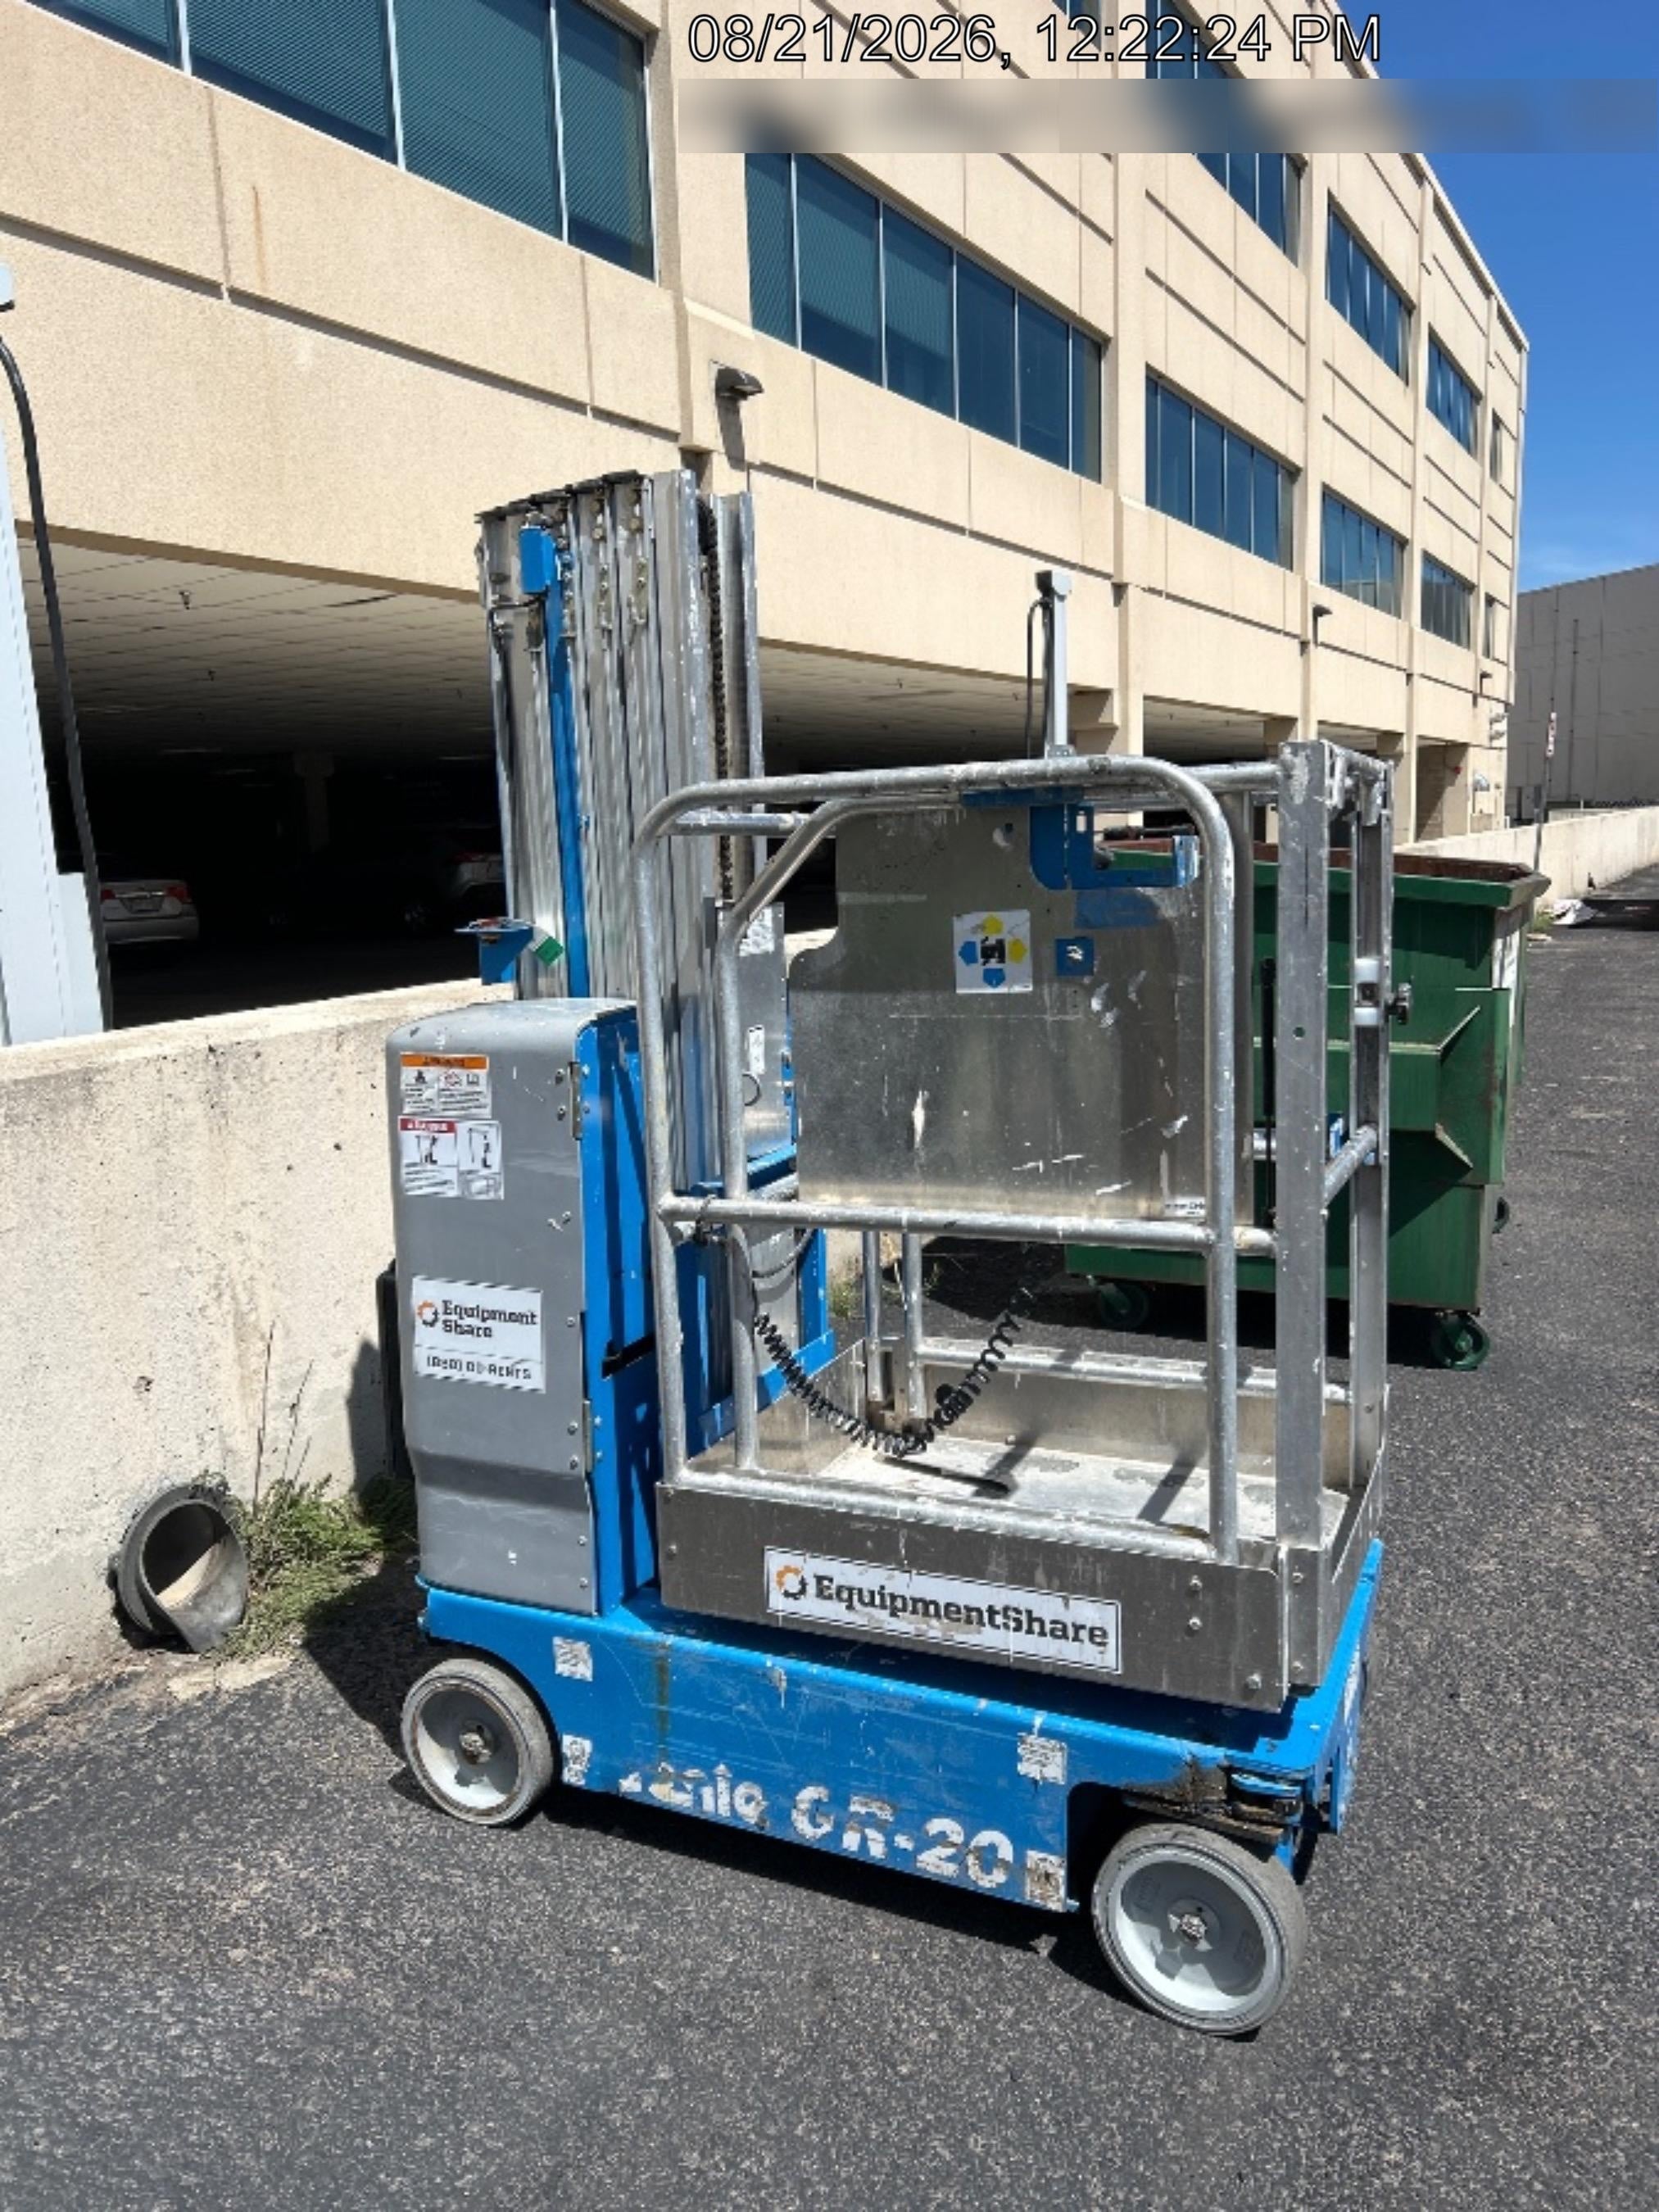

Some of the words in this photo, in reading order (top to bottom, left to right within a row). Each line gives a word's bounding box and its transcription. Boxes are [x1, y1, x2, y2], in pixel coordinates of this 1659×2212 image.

[442, 1299, 537, 1325] Equipment
[442, 1320, 492, 1338] Share
[814, 1574, 1109, 1648] EquipmentShare
